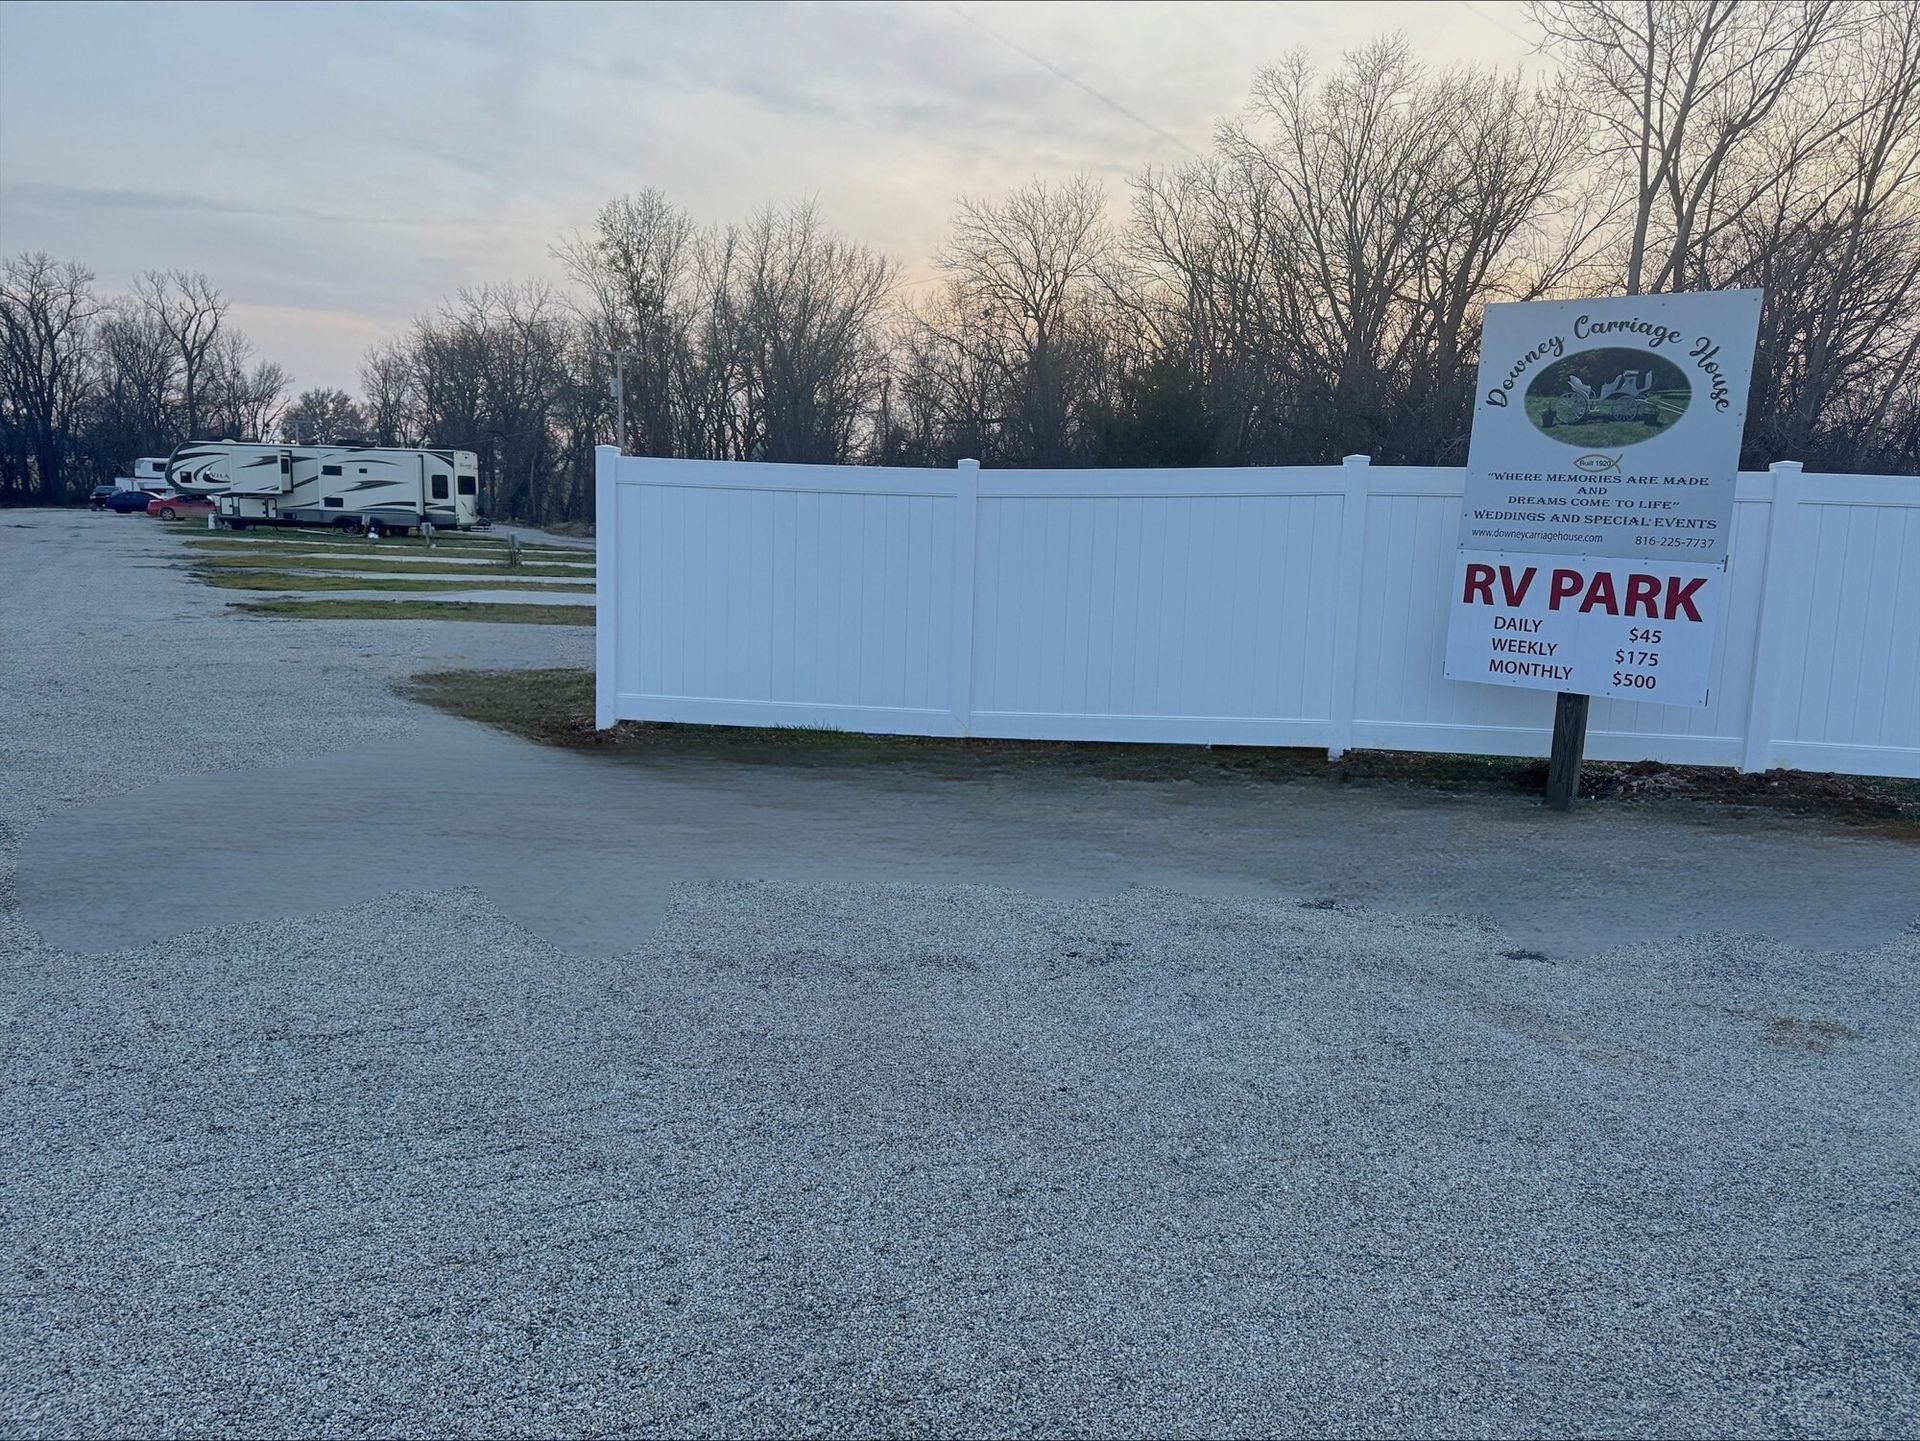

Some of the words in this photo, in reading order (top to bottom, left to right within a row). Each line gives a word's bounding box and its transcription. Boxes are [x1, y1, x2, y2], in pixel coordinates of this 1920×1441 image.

[1486, 334, 1565, 408] Downey
[1573, 315, 1682, 347] Carriage
[1688, 336, 1730, 414] House
[1546, 474, 1622, 484] MEMORIES
[1626, 475, 1658, 485] ARE
[1663, 476, 1709, 486] MADE
[1577, 486, 1607, 495] AND
[1508, 496, 1567, 506] DREAMS
[1571, 498, 1610, 508] COME
[1614, 499, 1634, 508] TO
[1473, 510, 1546, 522] WEDDINGS
[1549, 513, 1580, 524] AND
[1584, 515, 1649, 527] SPECIAL
[1654, 517, 1717, 530] EVENTS
[1471, 528, 1603, 543] www.downeycarriagehouse.com
[1635, 535, 1715, 549] 816-225-7737
[1463, 563, 1538, 608] RV
[1548, 568, 1708, 622] PARK
[1493, 616, 1543, 633] DAILY
[1628, 626, 1662, 644] $45
[1491, 637, 1558, 657] WEEKLY
[1615, 649, 1659, 667] $175
[1489, 658, 1573, 680] MONTHLY
[1612, 671, 1657, 690] $500
